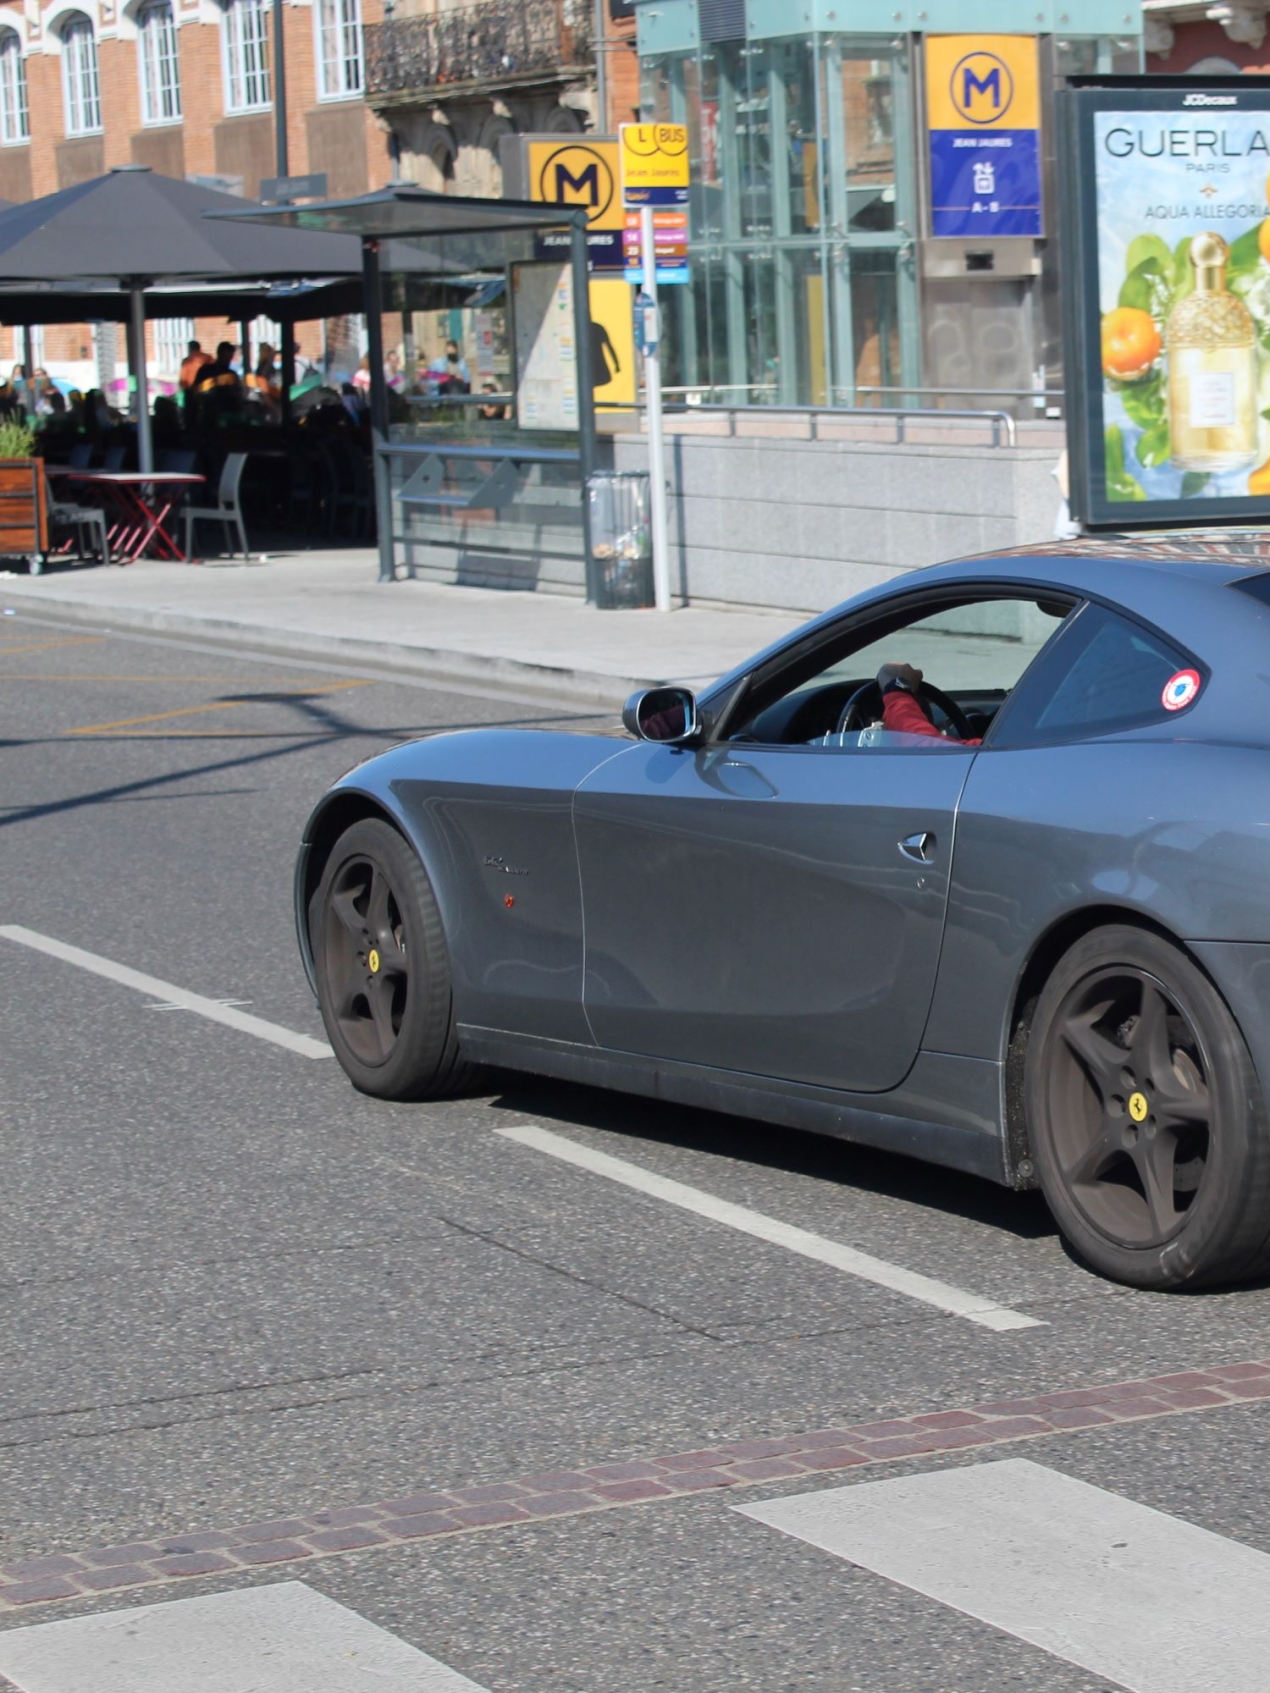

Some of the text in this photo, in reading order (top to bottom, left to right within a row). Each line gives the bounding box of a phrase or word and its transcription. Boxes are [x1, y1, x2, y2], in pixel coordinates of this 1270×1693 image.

[963, 67, 1000, 108] M
[1183, 94, 1238, 107] JCDecaux
[660, 128, 685, 143] BUS
[953, 138, 977, 147] JEAN
[1185, 163, 1231, 174] PARIS
[555, 164, 598, 206] M
[1144, 205, 1190, 220] AQUA
